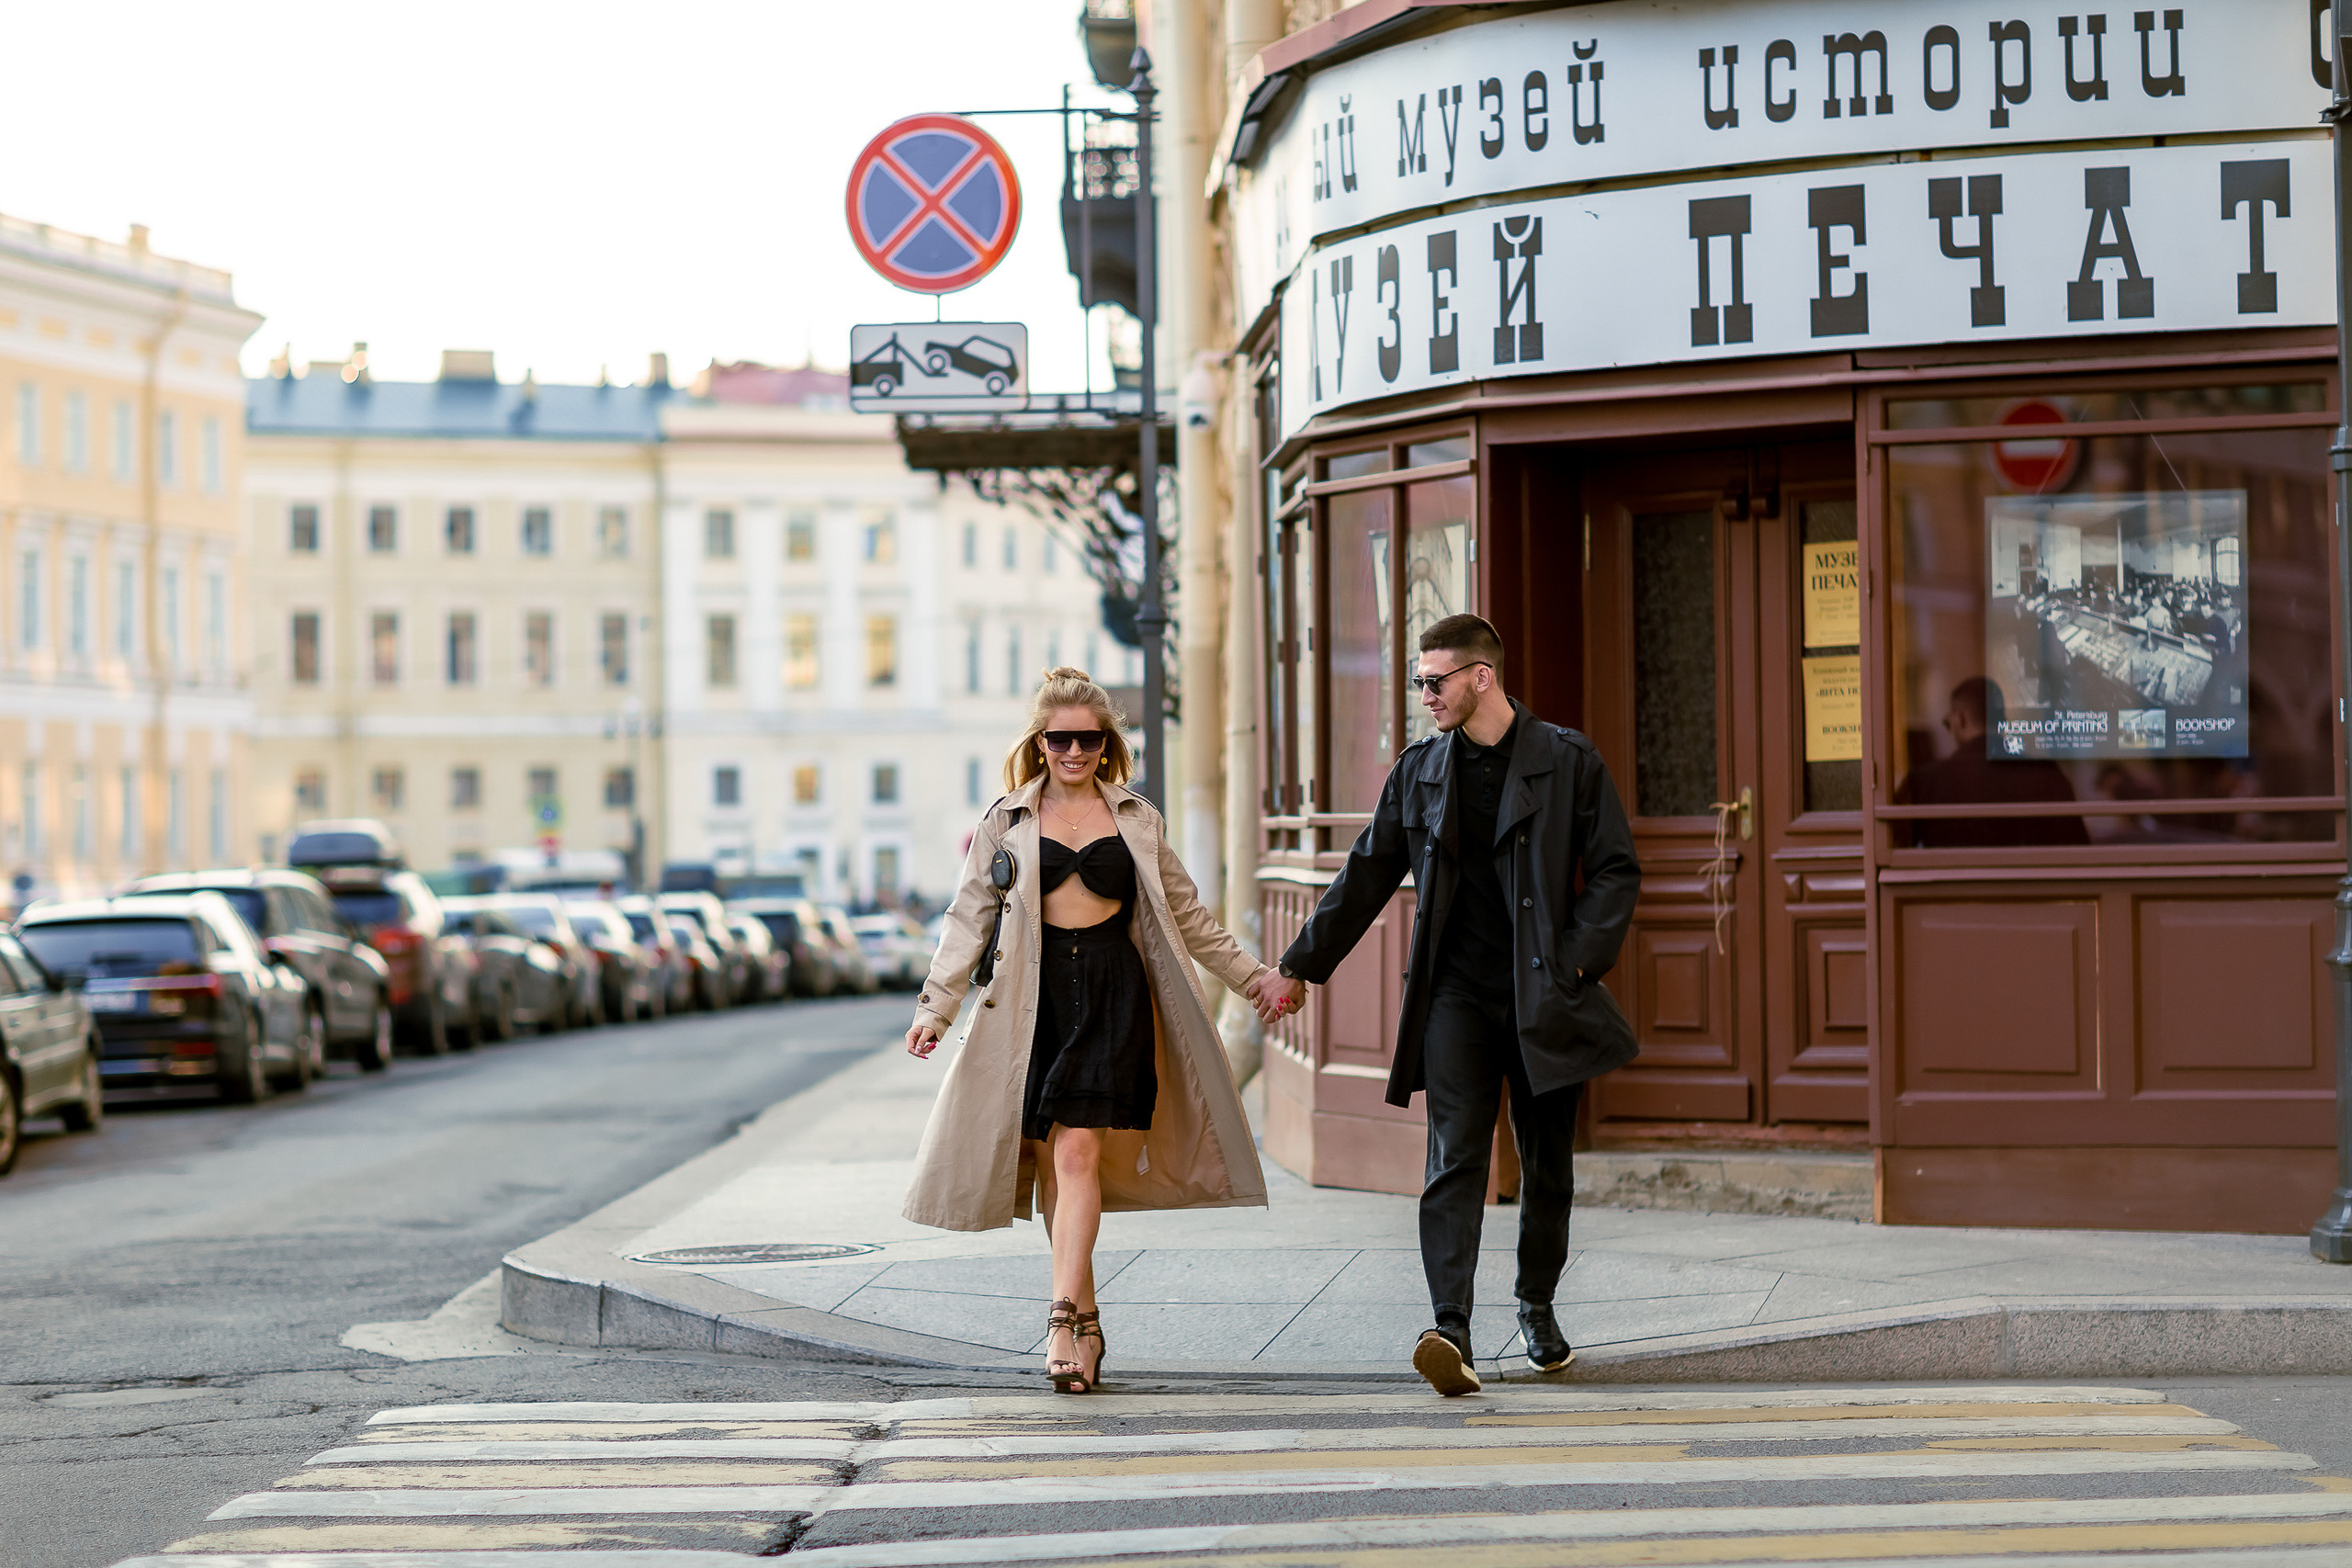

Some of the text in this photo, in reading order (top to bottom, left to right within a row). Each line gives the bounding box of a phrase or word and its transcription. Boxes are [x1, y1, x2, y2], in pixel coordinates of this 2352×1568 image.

[1397, 38, 1606, 188] музей
[1698, 8, 2187, 130] истории
[1812, 573, 1860, 591] ПЕЧА
[1997, 719, 2108, 734] MUSEUM OF PRINTING
[2176, 718, 2235, 732] BOOKSHOP
